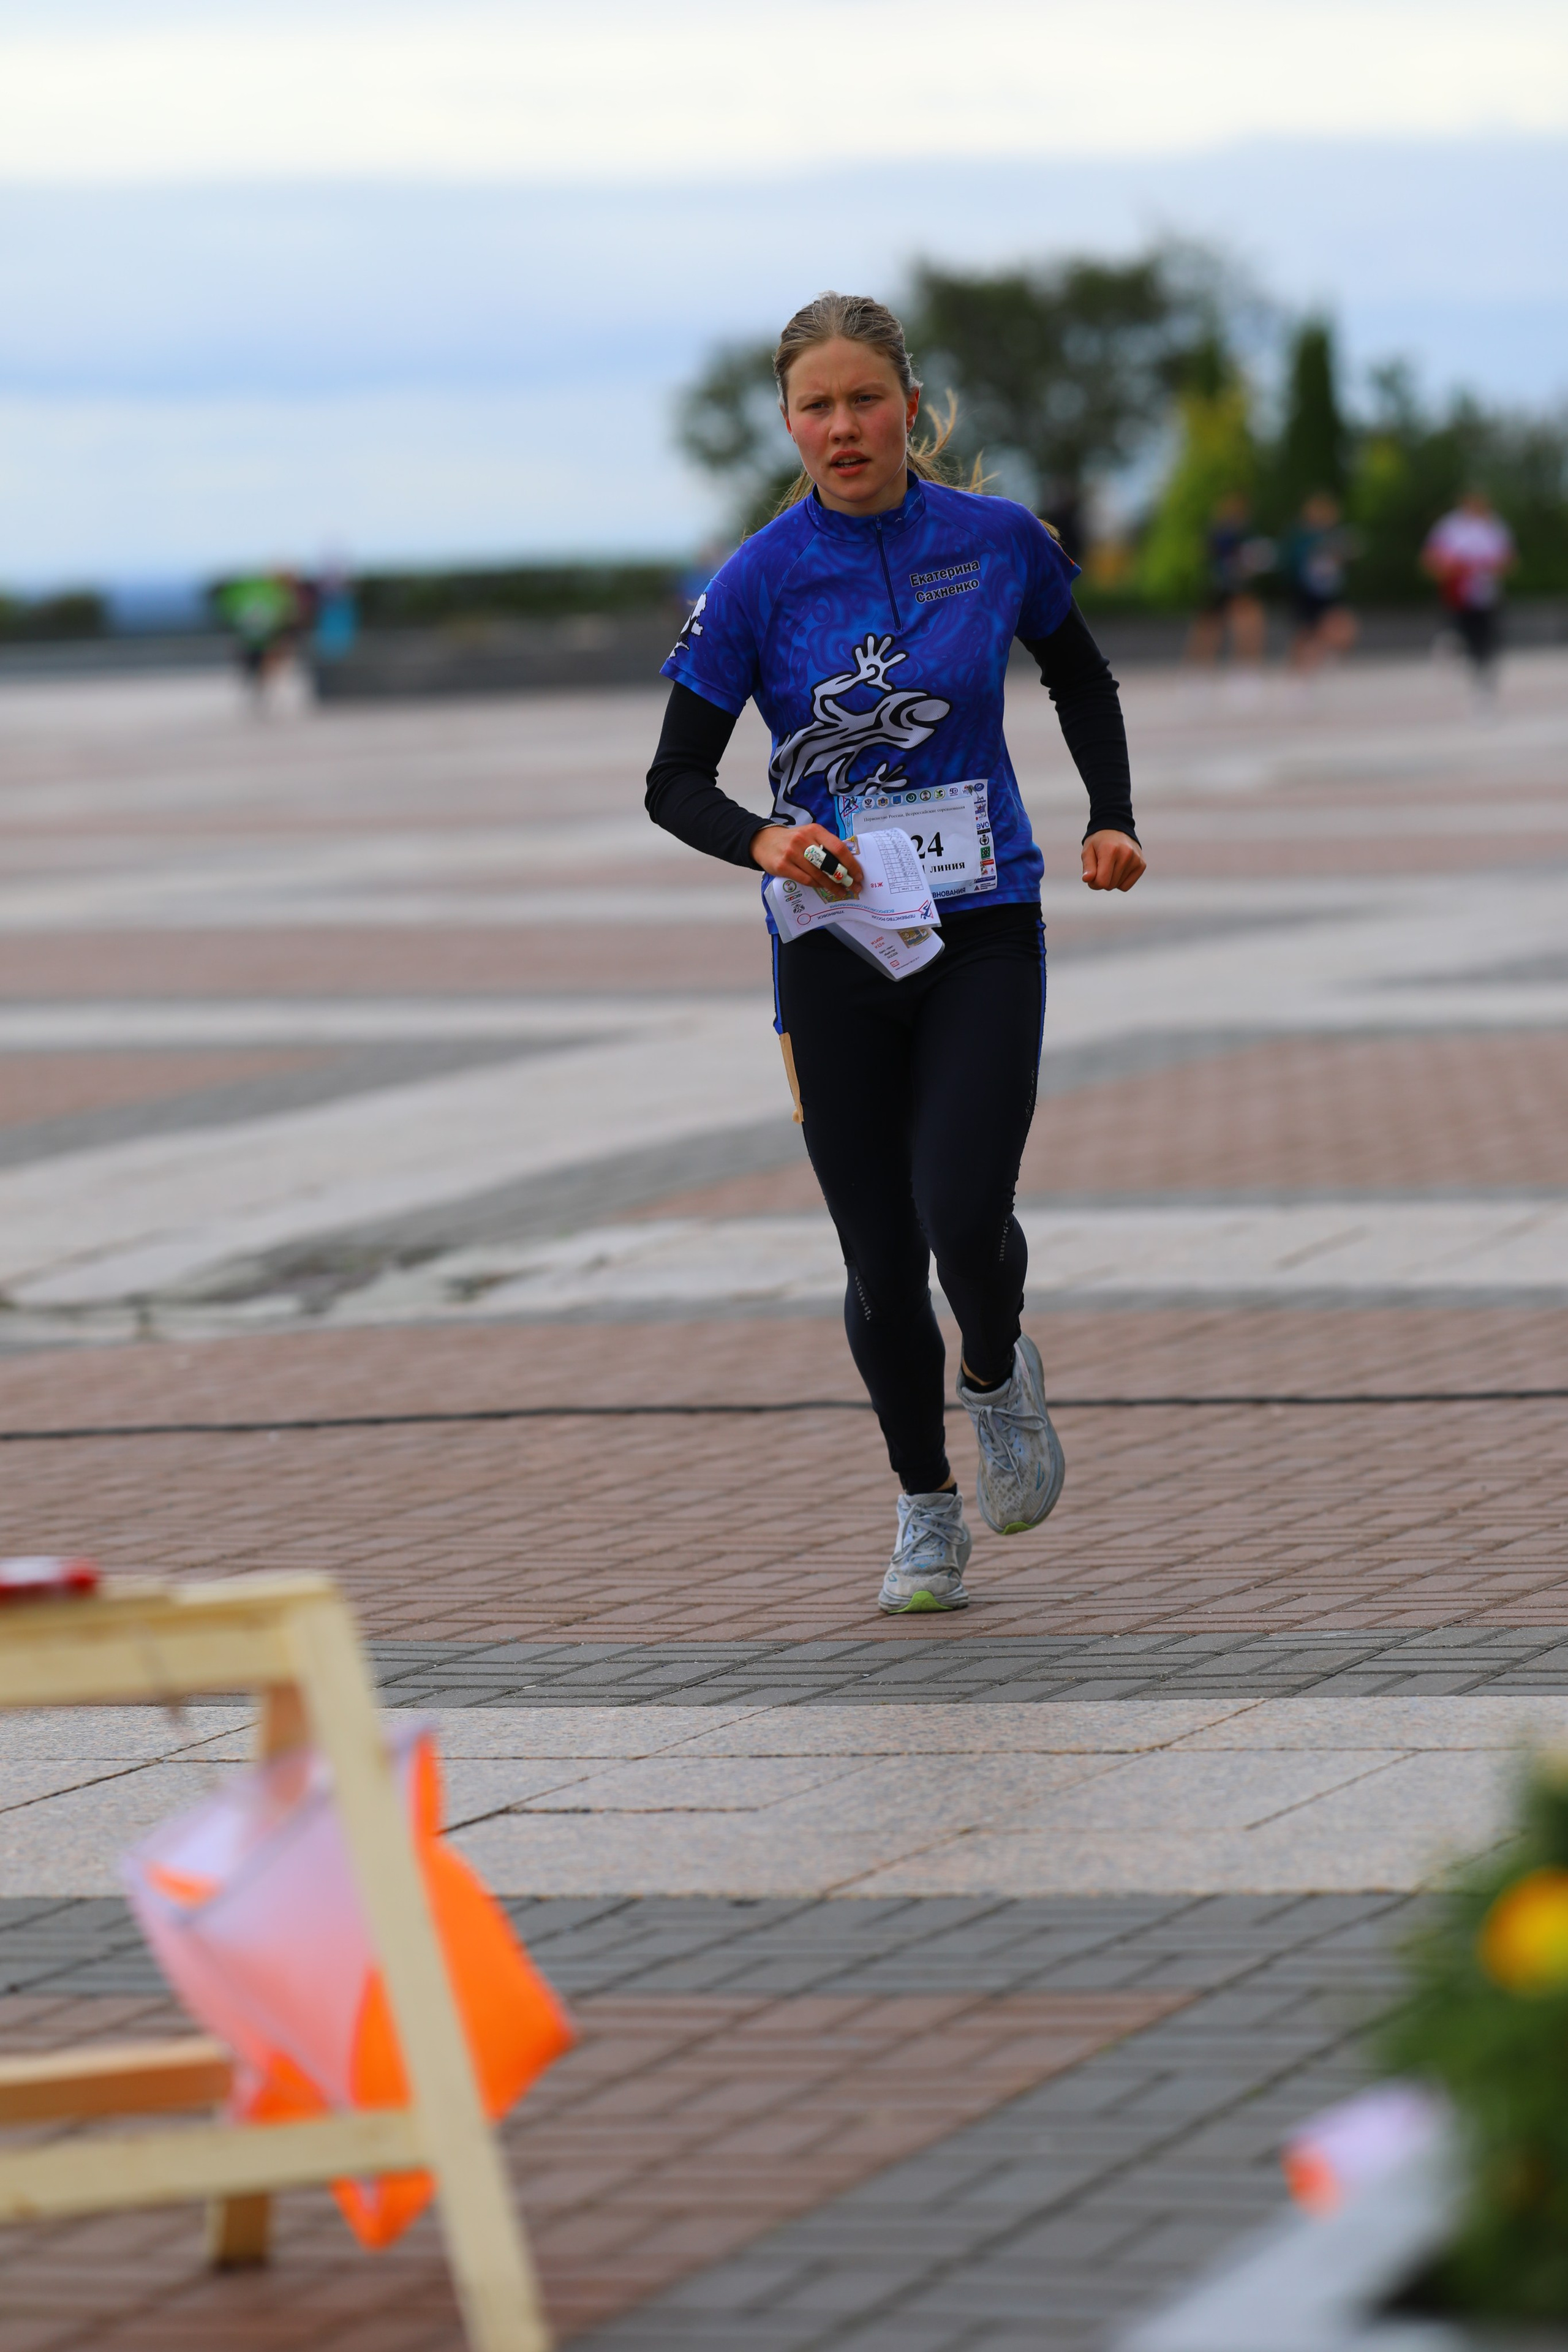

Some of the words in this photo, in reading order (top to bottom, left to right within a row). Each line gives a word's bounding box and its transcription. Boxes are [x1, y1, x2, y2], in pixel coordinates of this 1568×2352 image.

[910, 560, 980, 587] Екатерина
[915, 579, 979, 603] Сахненко
[905, 809, 937, 817] Всероссийские
[930, 862, 965, 873] линия
[932, 887, 966, 899] ВНОВАНИЯ
[818, 910, 845, 919] УЛЬЯНОВСК
